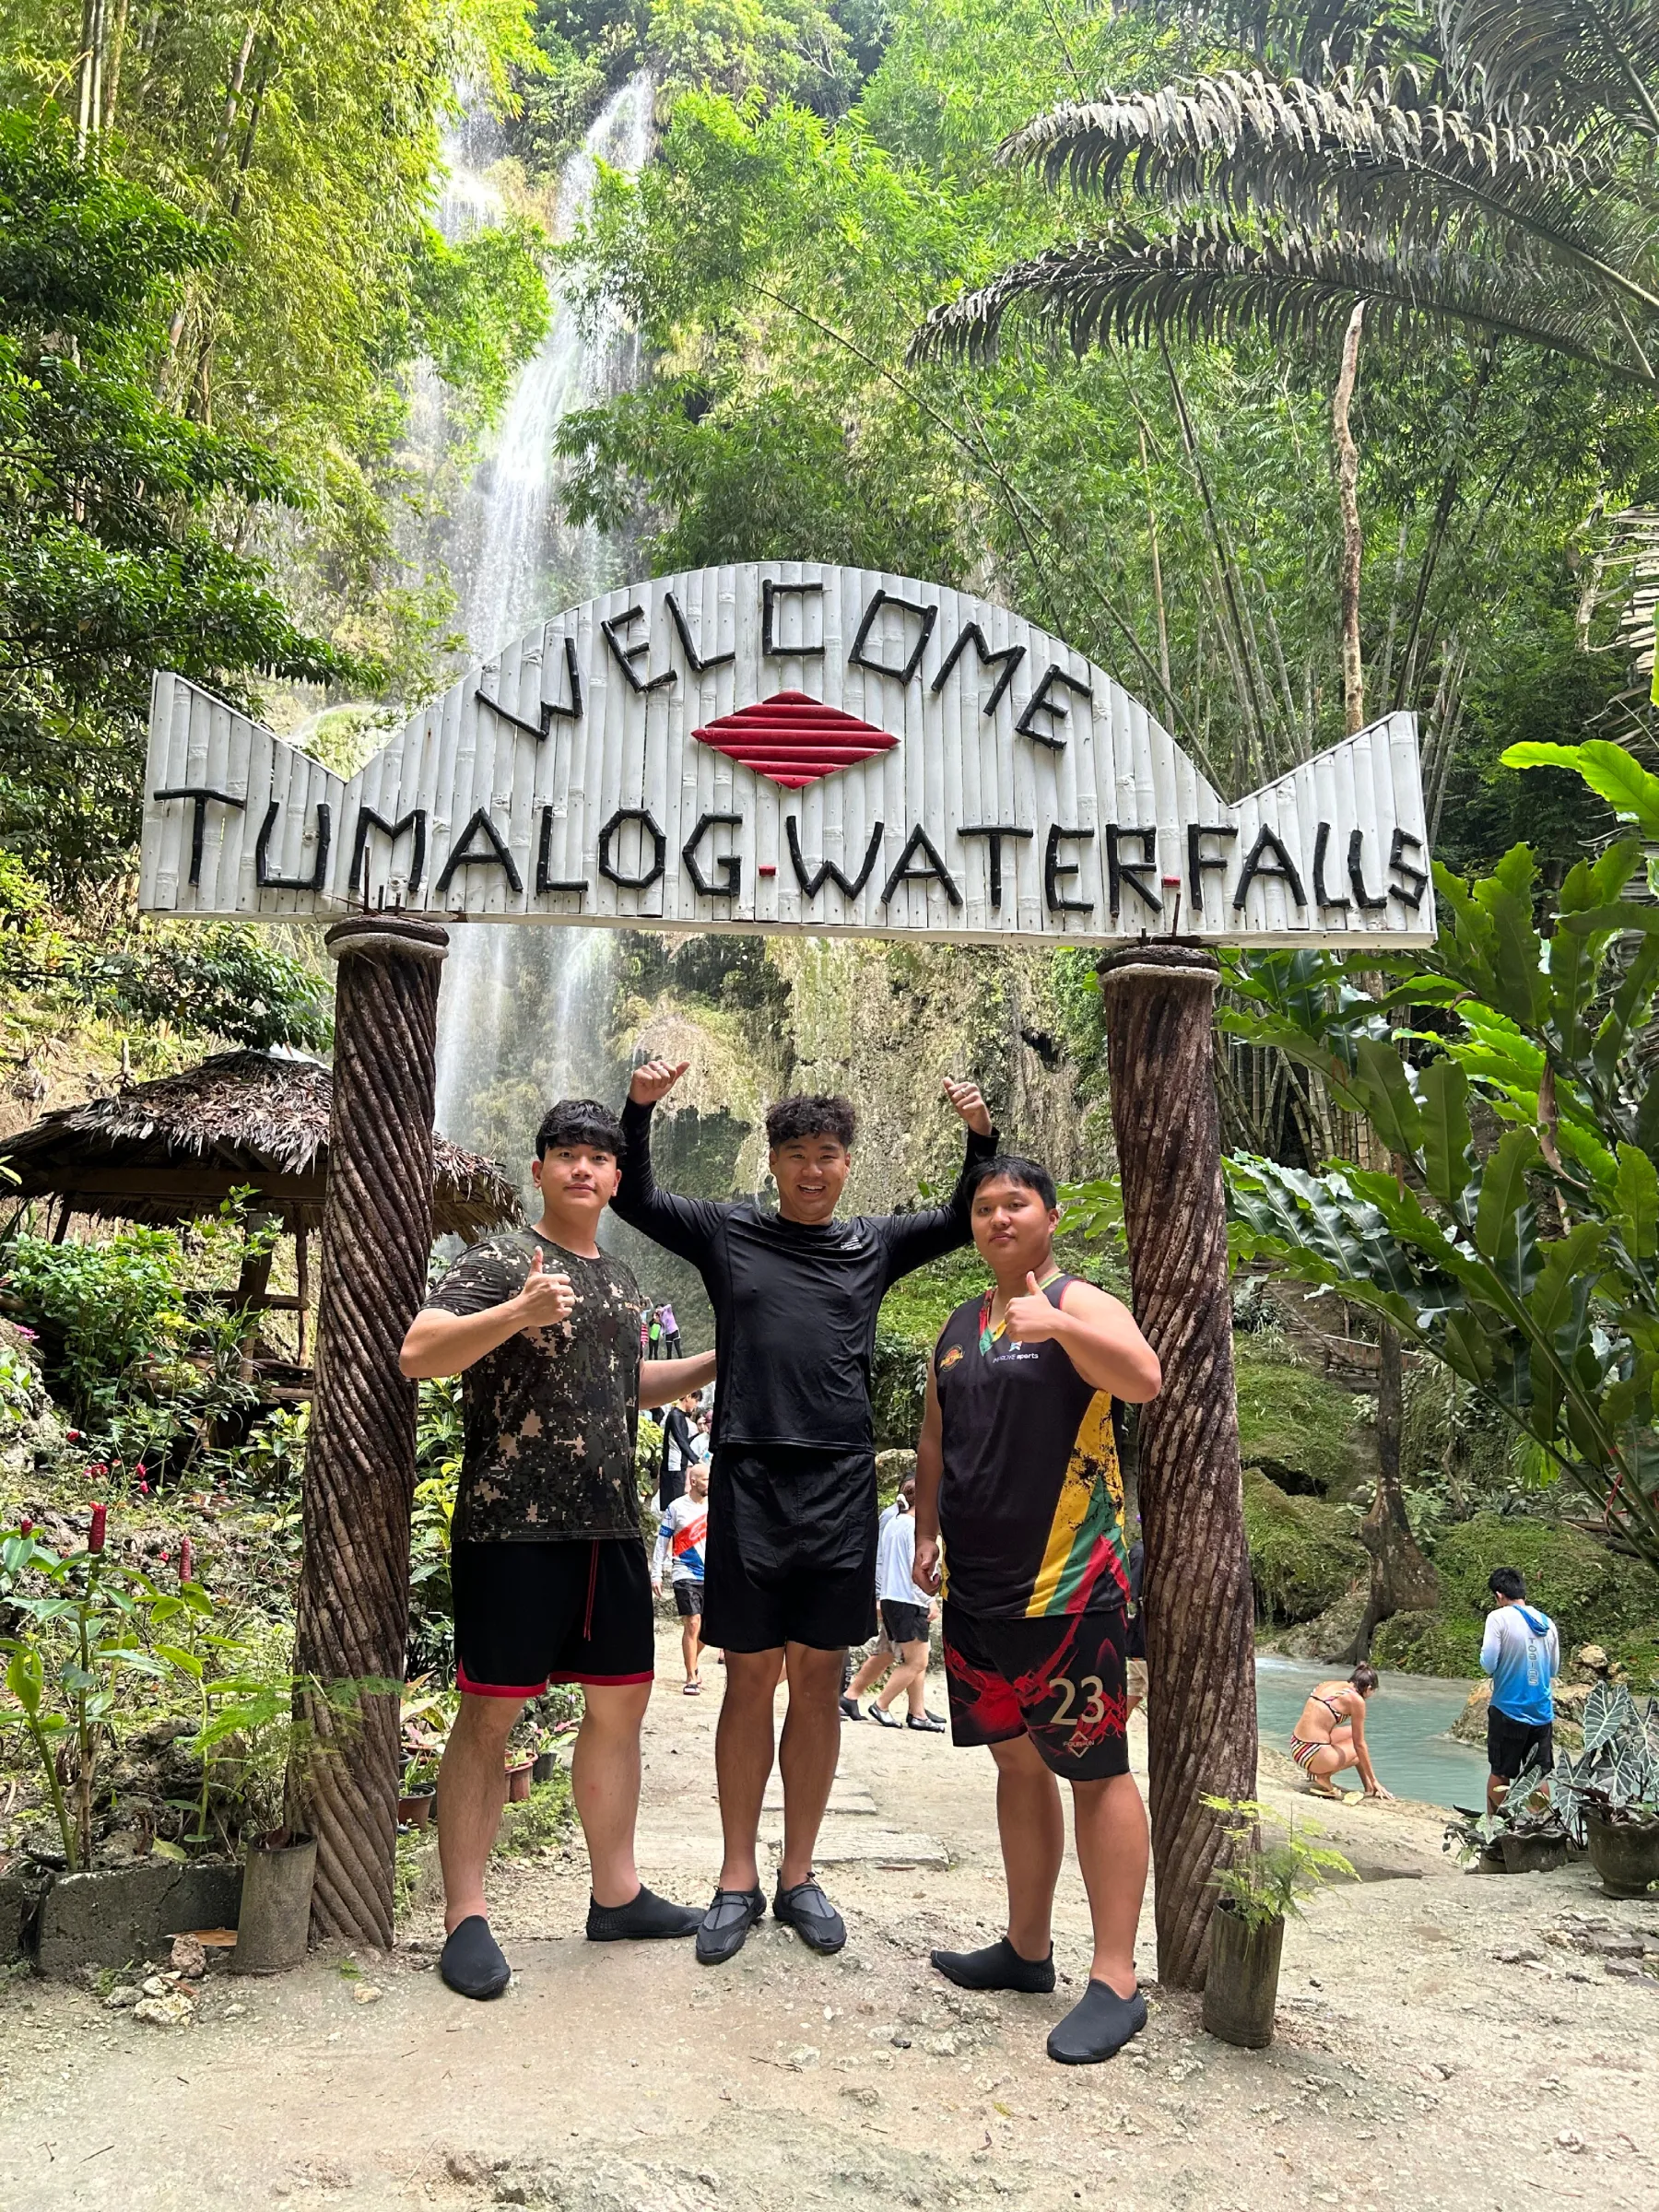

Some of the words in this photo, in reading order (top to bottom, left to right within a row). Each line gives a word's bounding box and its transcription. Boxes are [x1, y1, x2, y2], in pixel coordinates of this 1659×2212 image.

[475, 578, 1094, 751] WELCOME
[152, 787, 743, 898] TUMALOG
[785, 815, 1163, 919] WATER
[1188, 821, 1429, 912] FALLS
[1049, 1675, 1105, 1725] 23
